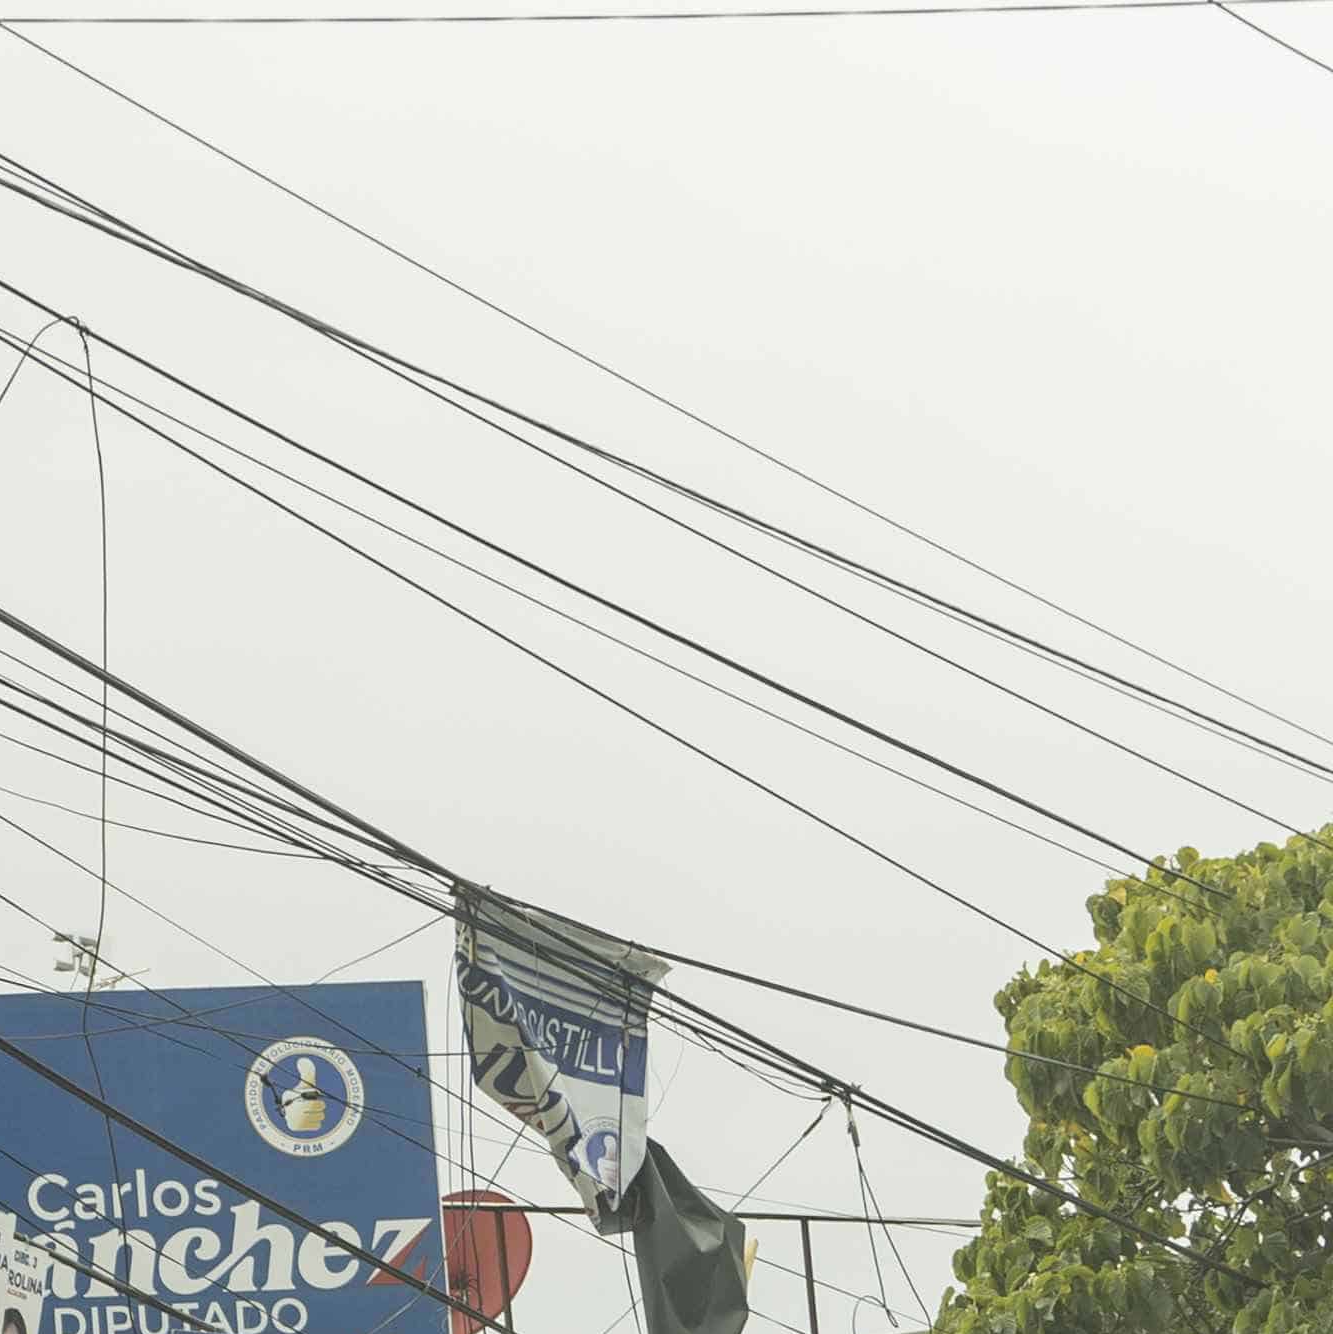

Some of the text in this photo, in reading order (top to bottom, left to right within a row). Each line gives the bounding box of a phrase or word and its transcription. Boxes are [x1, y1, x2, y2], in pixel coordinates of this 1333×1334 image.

[293, 1143, 324, 1154] PRM
[27, 1169, 222, 1222] Carlos
[23, 1201, 433, 1302] ánchez
[7, 1270, 43, 1296] ROLINA
